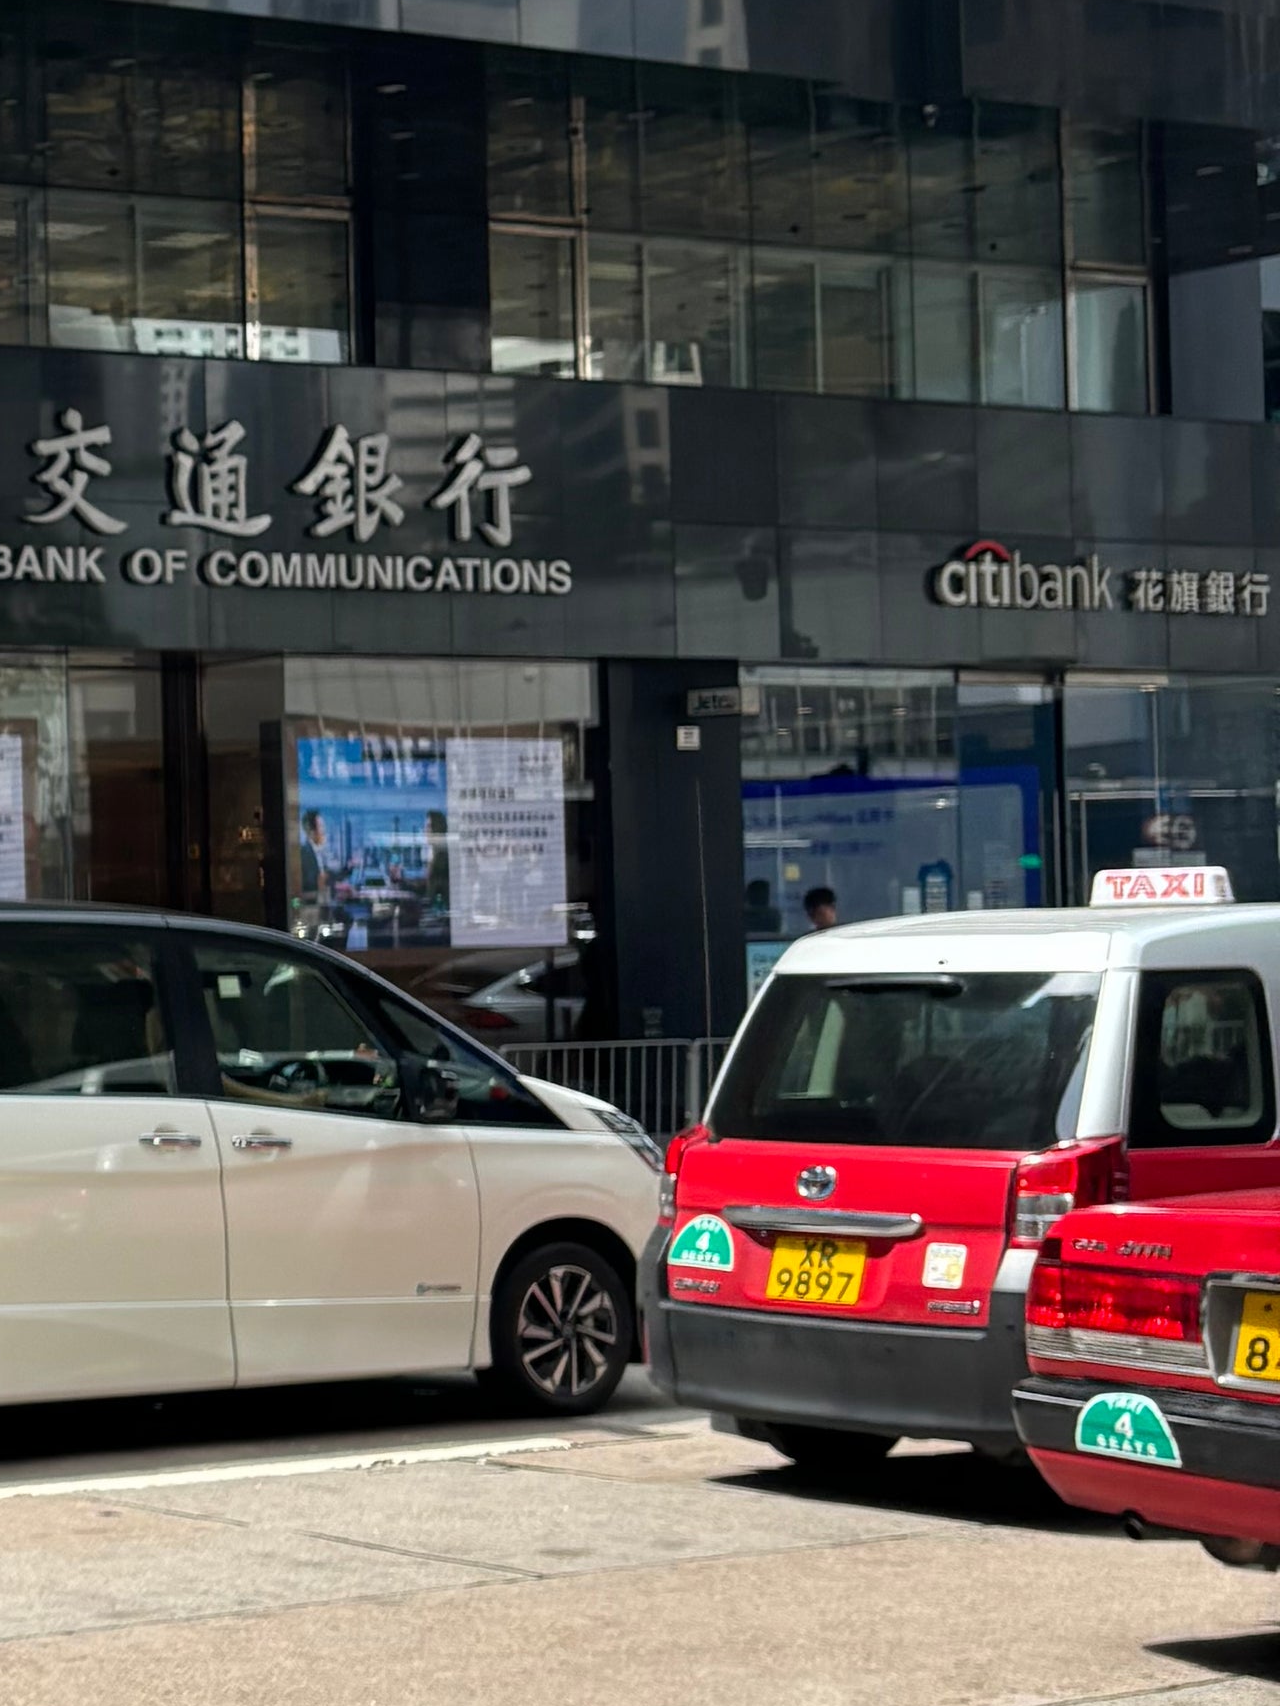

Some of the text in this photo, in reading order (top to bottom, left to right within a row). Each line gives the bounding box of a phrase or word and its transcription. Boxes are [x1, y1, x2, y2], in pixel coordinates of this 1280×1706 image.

[22, 407, 533, 547] 交通銀行
[130, 547, 189, 585] OF
[207, 549, 573, 594] COMMUNICATIONS
[939, 541, 1114, 611] citibank
[1131, 568, 1271, 617] 花旗銀行
[1105, 872, 1206, 900] TAXI
[695, 1230, 711, 1252] 4
[800, 1239, 839, 1269] XR
[776, 1268, 855, 1302] 9897
[1113, 1411, 1134, 1440] 4
